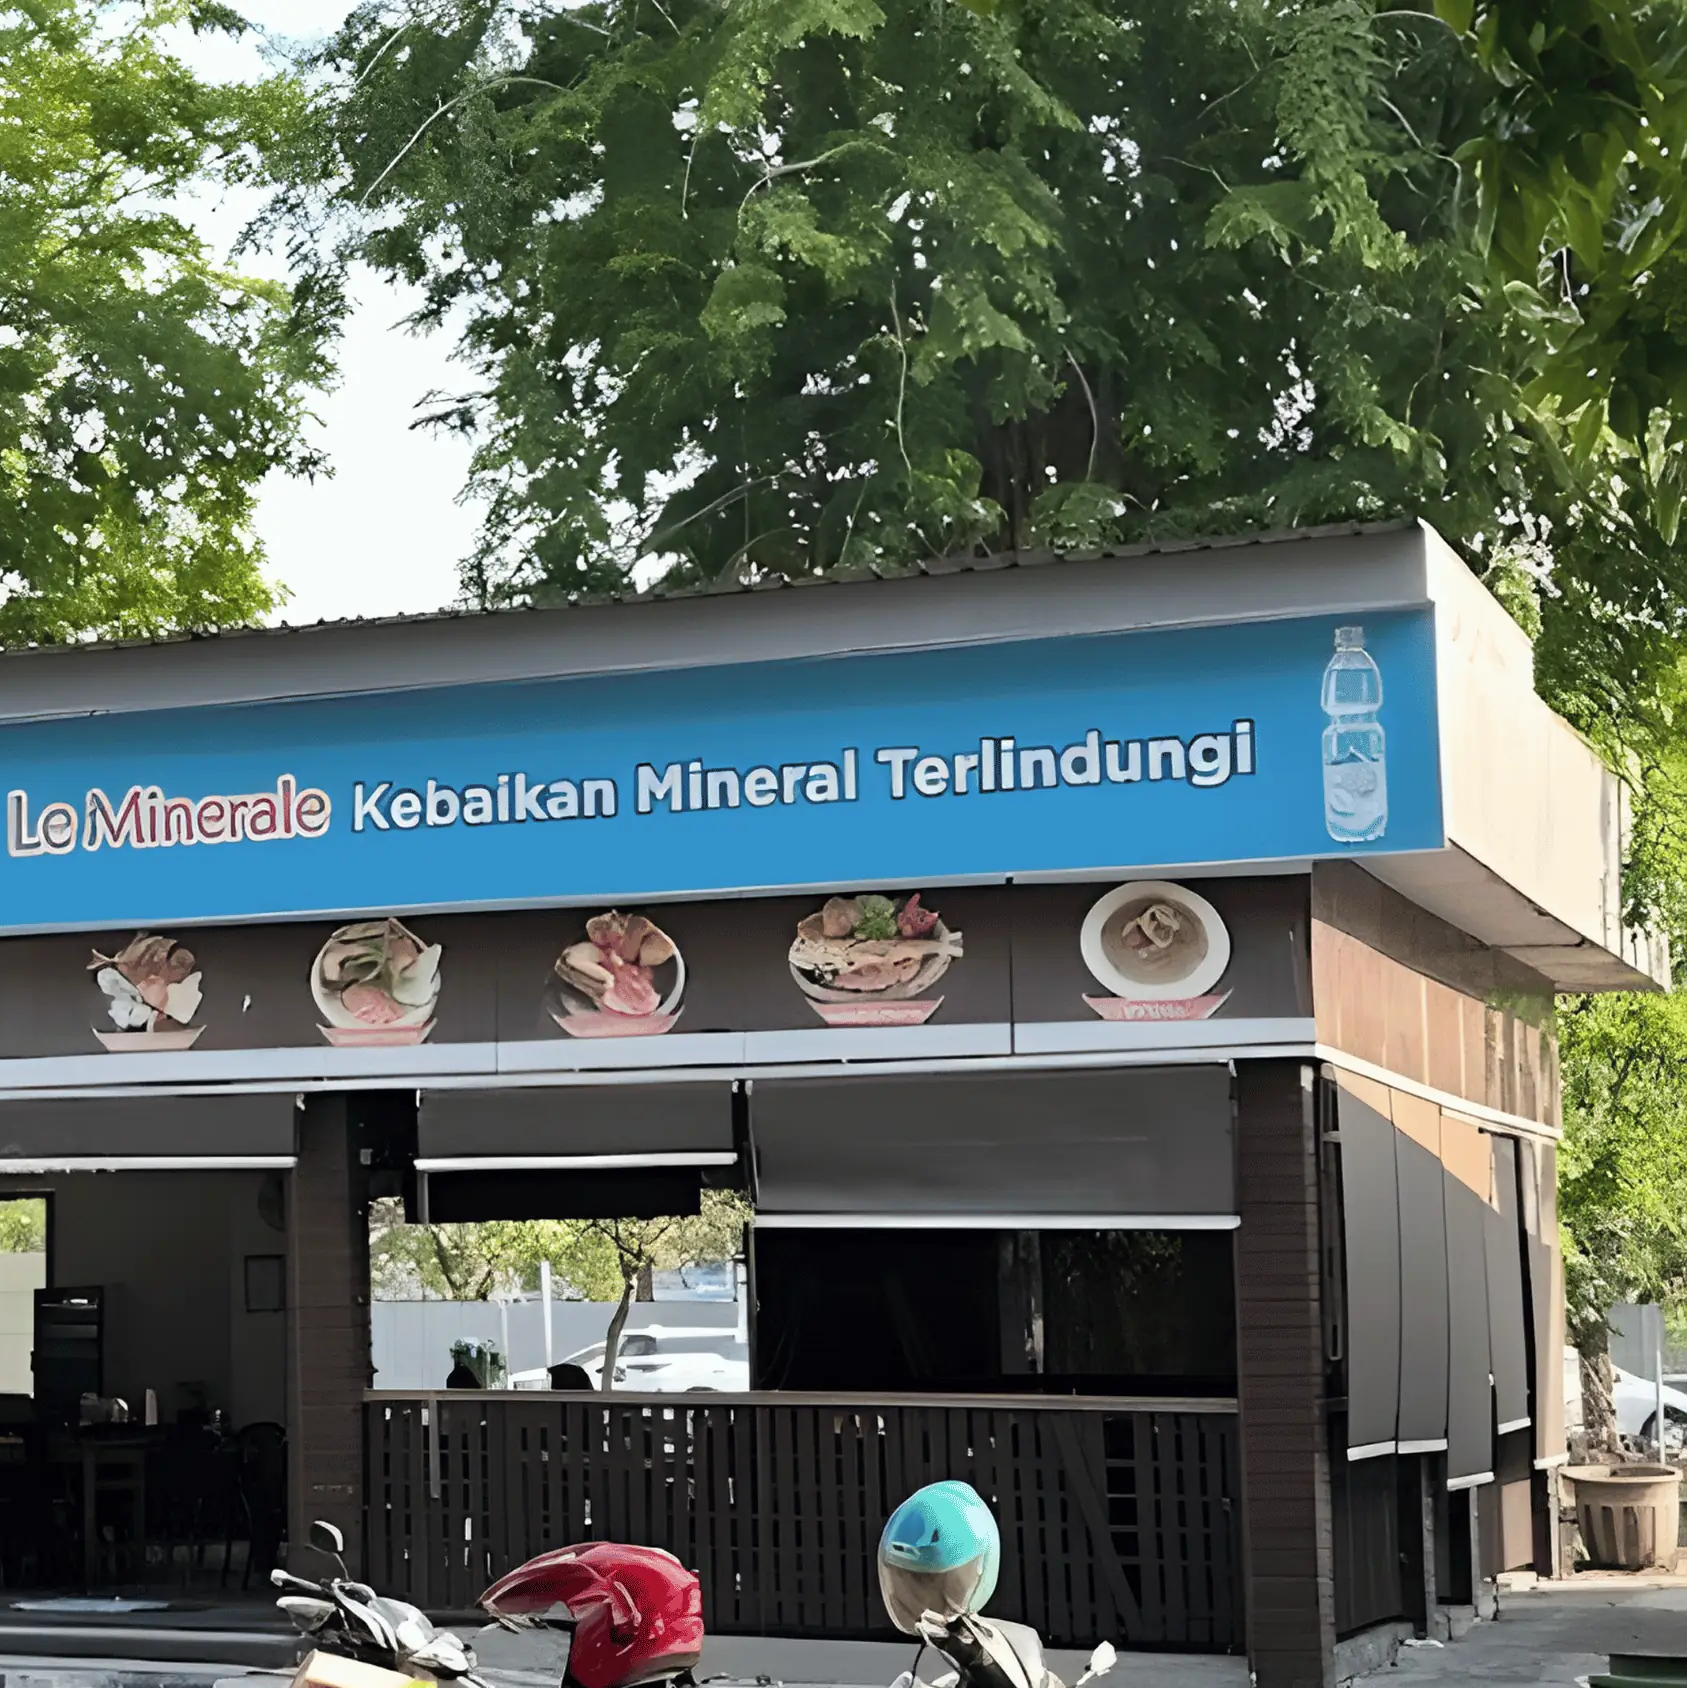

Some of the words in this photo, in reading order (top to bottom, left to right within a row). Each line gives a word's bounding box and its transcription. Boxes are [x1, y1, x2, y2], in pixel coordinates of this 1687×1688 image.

[83, 775, 330, 850] Minerale
[350, 774, 618, 833] Kebaikan
[635, 747, 859, 814] Mineral
[874, 718, 1256, 800] Terlindungi
